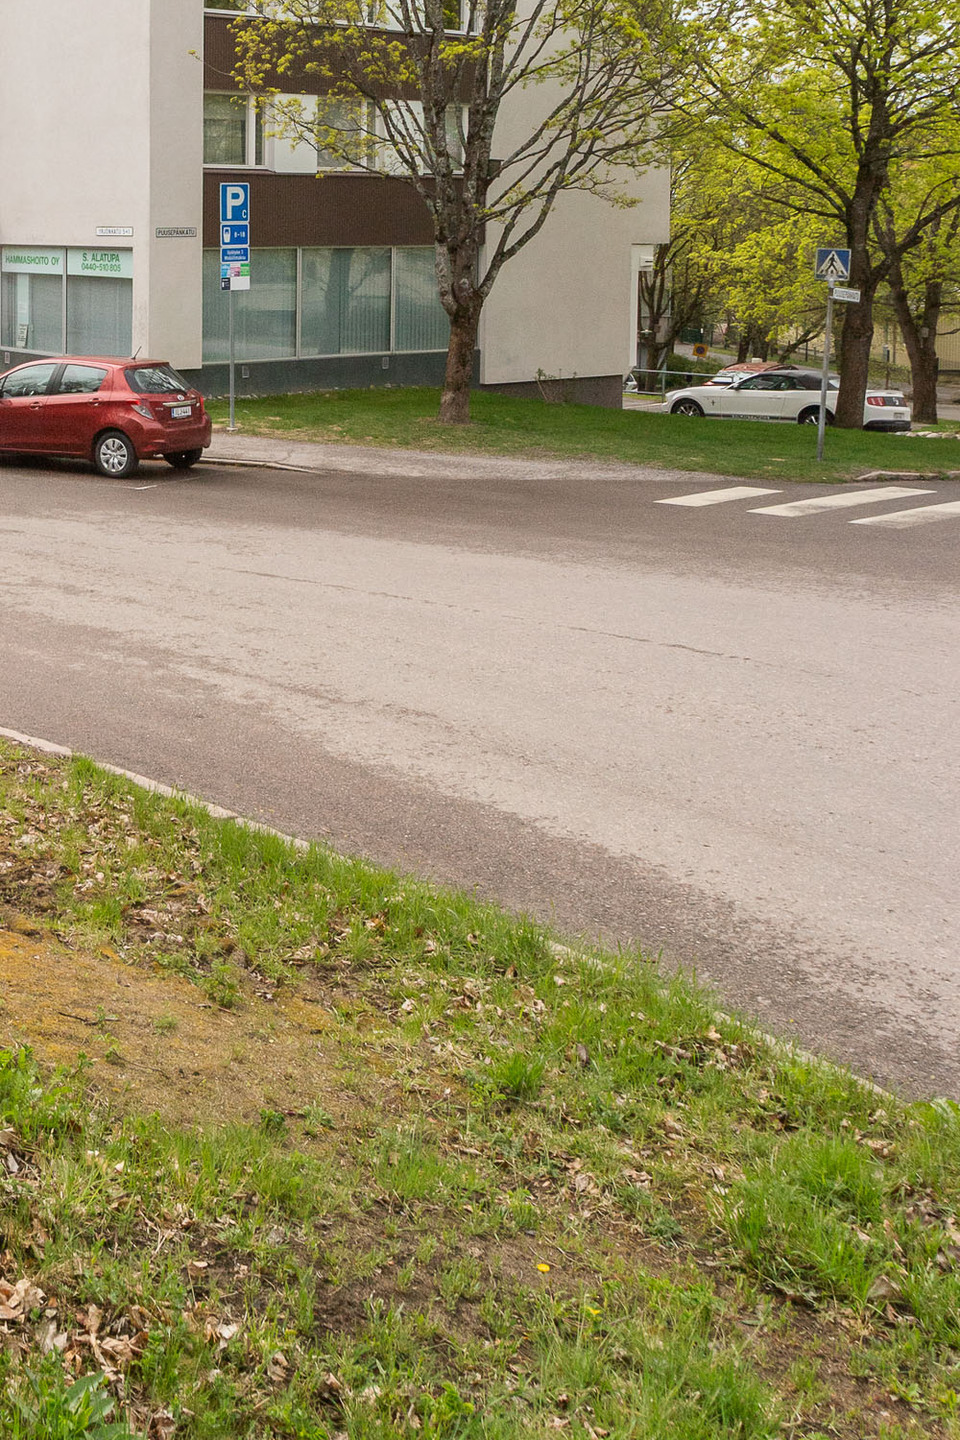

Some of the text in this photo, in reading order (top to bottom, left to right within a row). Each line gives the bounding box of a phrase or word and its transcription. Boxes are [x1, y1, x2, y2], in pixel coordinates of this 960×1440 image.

[227, 186, 245, 219] P
[5, 254, 60, 266] HAMMASHOITO OY
[91, 253, 120, 262] ALATUPA
